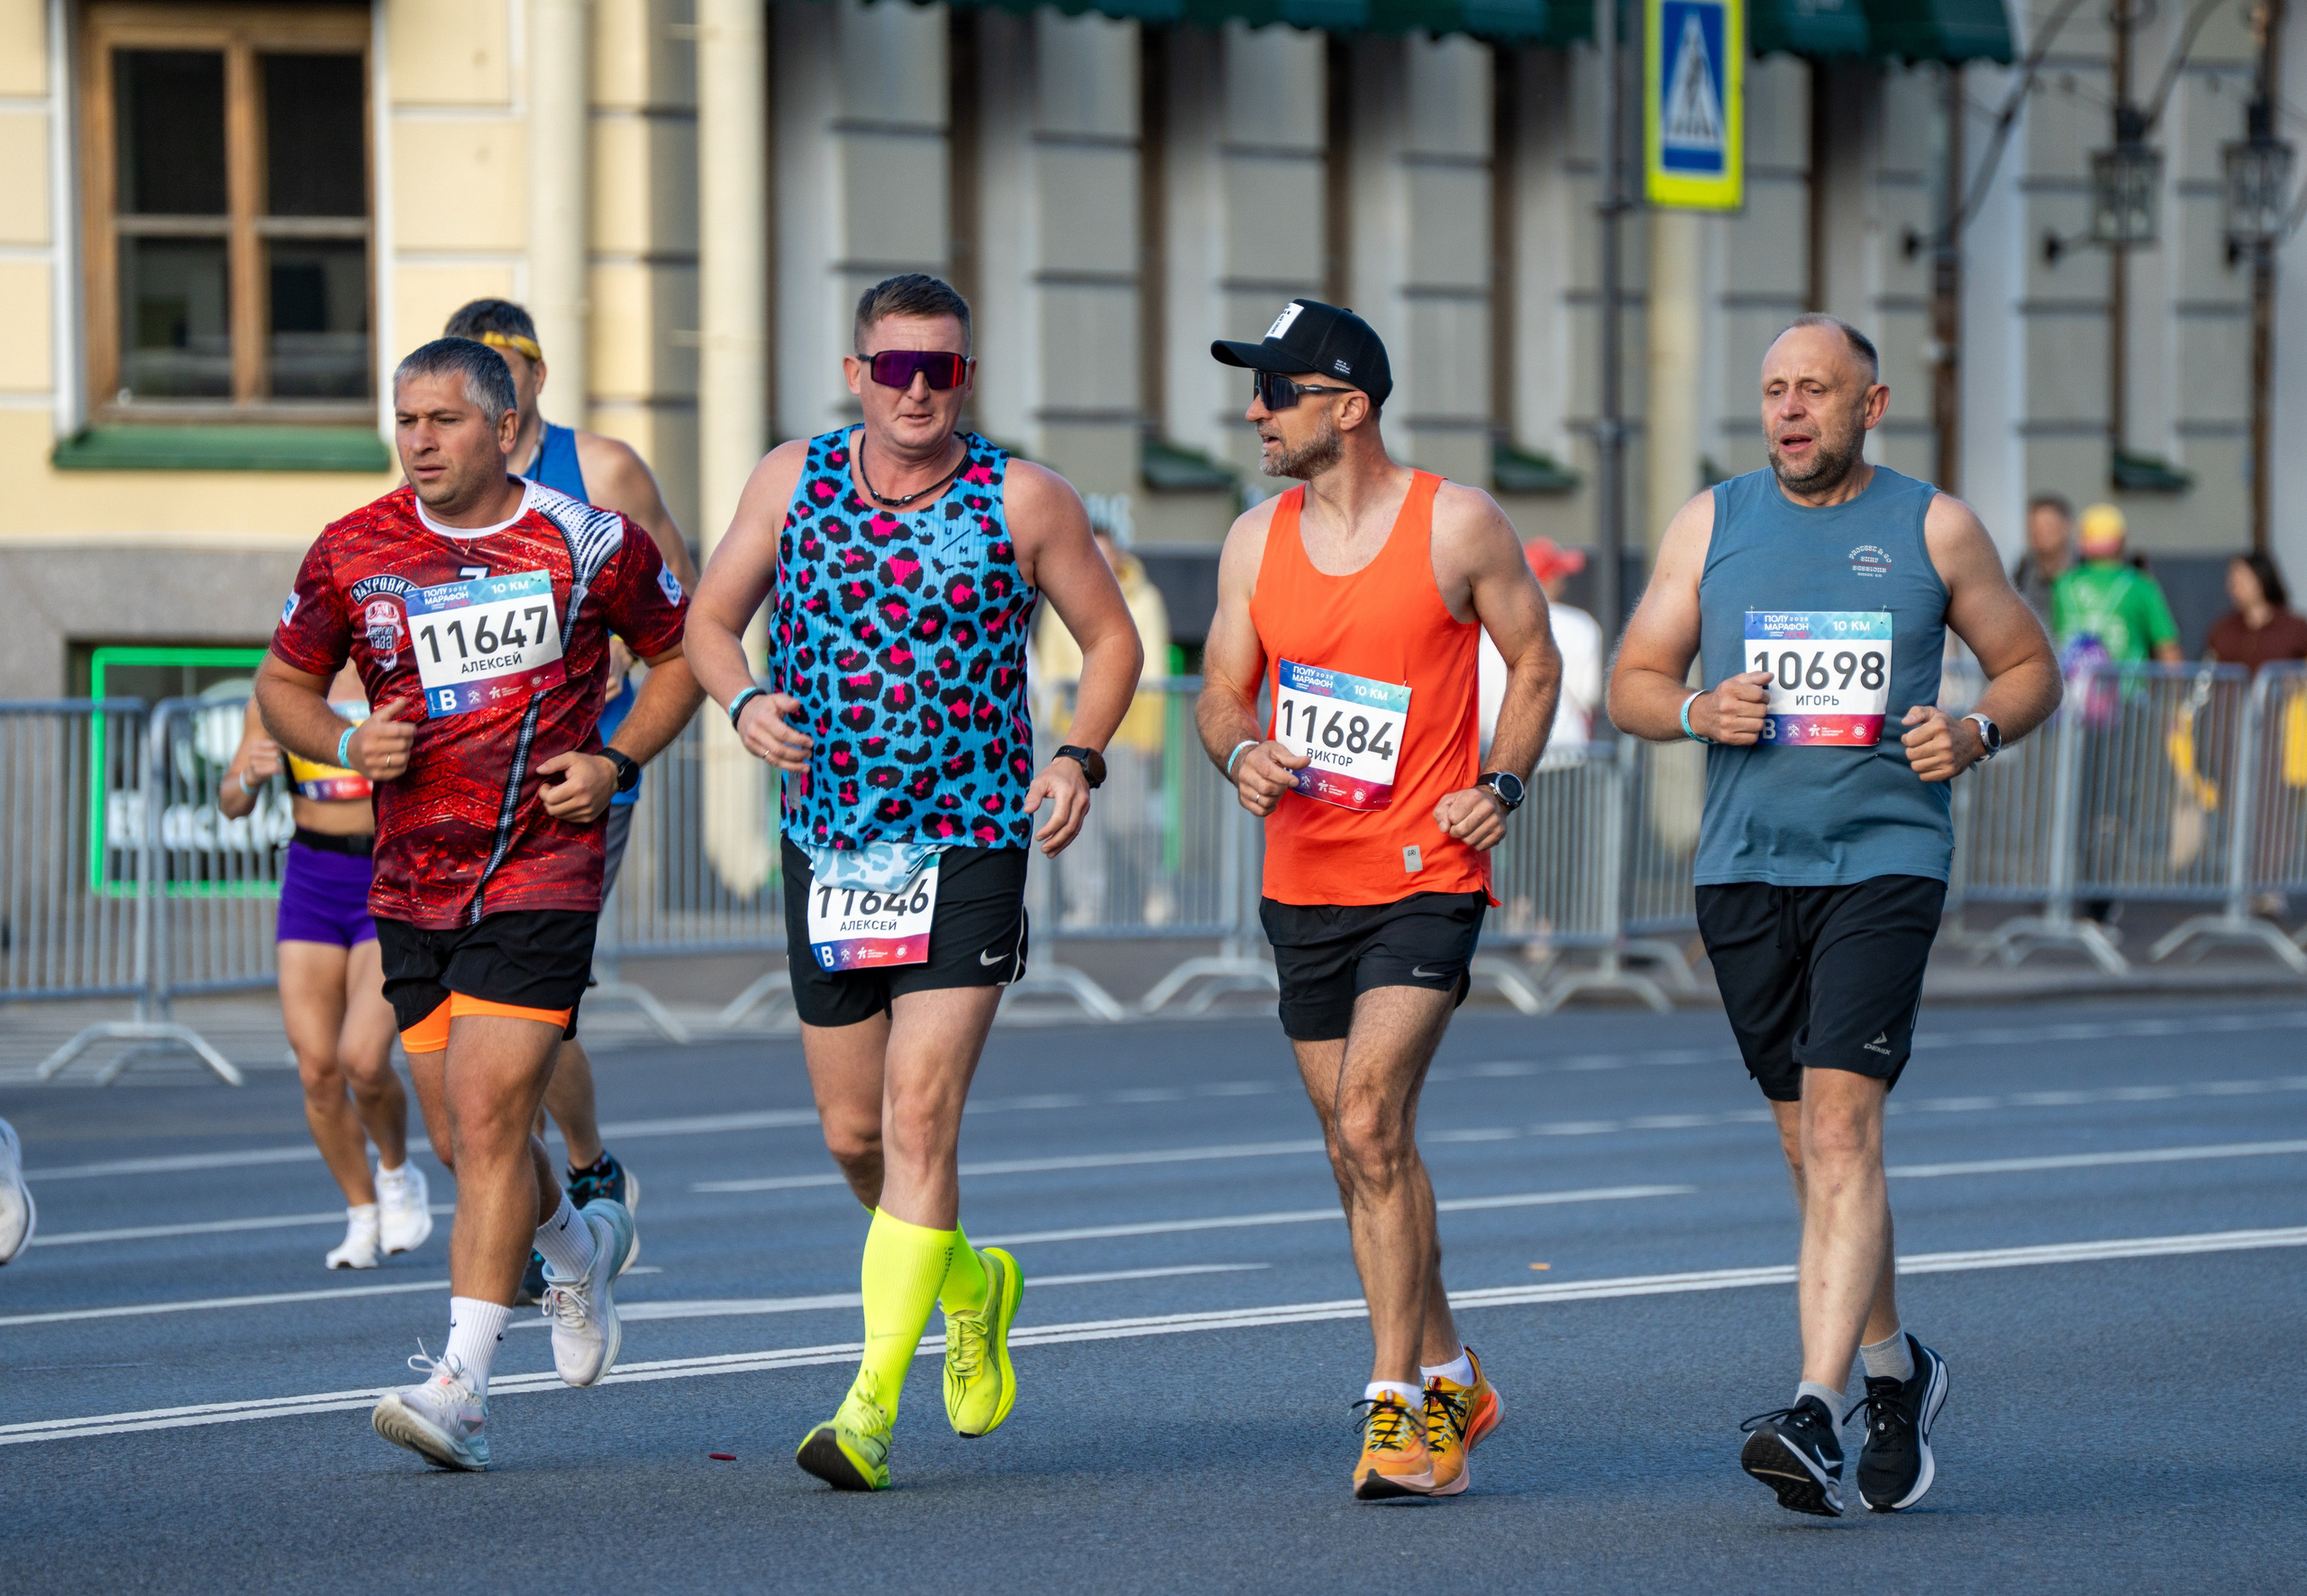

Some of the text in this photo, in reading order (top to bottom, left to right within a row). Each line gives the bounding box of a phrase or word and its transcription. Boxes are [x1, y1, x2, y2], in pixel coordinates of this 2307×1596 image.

[424, 587, 448, 598] ПОЛУ
[491, 579, 529, 594] 10 КМ
[424, 591, 469, 606] МАРАФОН
[1764, 615, 1789, 623] ПОЛУ
[1833, 621, 1870, 631] 10 КМ
[420, 605, 549, 663] 11647
[1764, 623, 1809, 631] МАРАФОН
[461, 652, 523, 674] АЛЕКСЕЙ
[1754, 651, 1885, 690] 10698
[1293, 665, 1316, 677] ПОЛУ
[1292, 674, 1334, 689] МАРАФОН
[1354, 685, 1389, 701] 10 КМ
[1796, 695, 1839, 706] ИГОРЬ
[1281, 698, 1394, 762] 11684
[1306, 748, 1354, 767] ВИКТОР
[816, 879, 929, 918] 11646
[840, 919, 898, 932] АЛЕКСЕЙ
[1864, 1043, 1892, 1055] DEMIX
